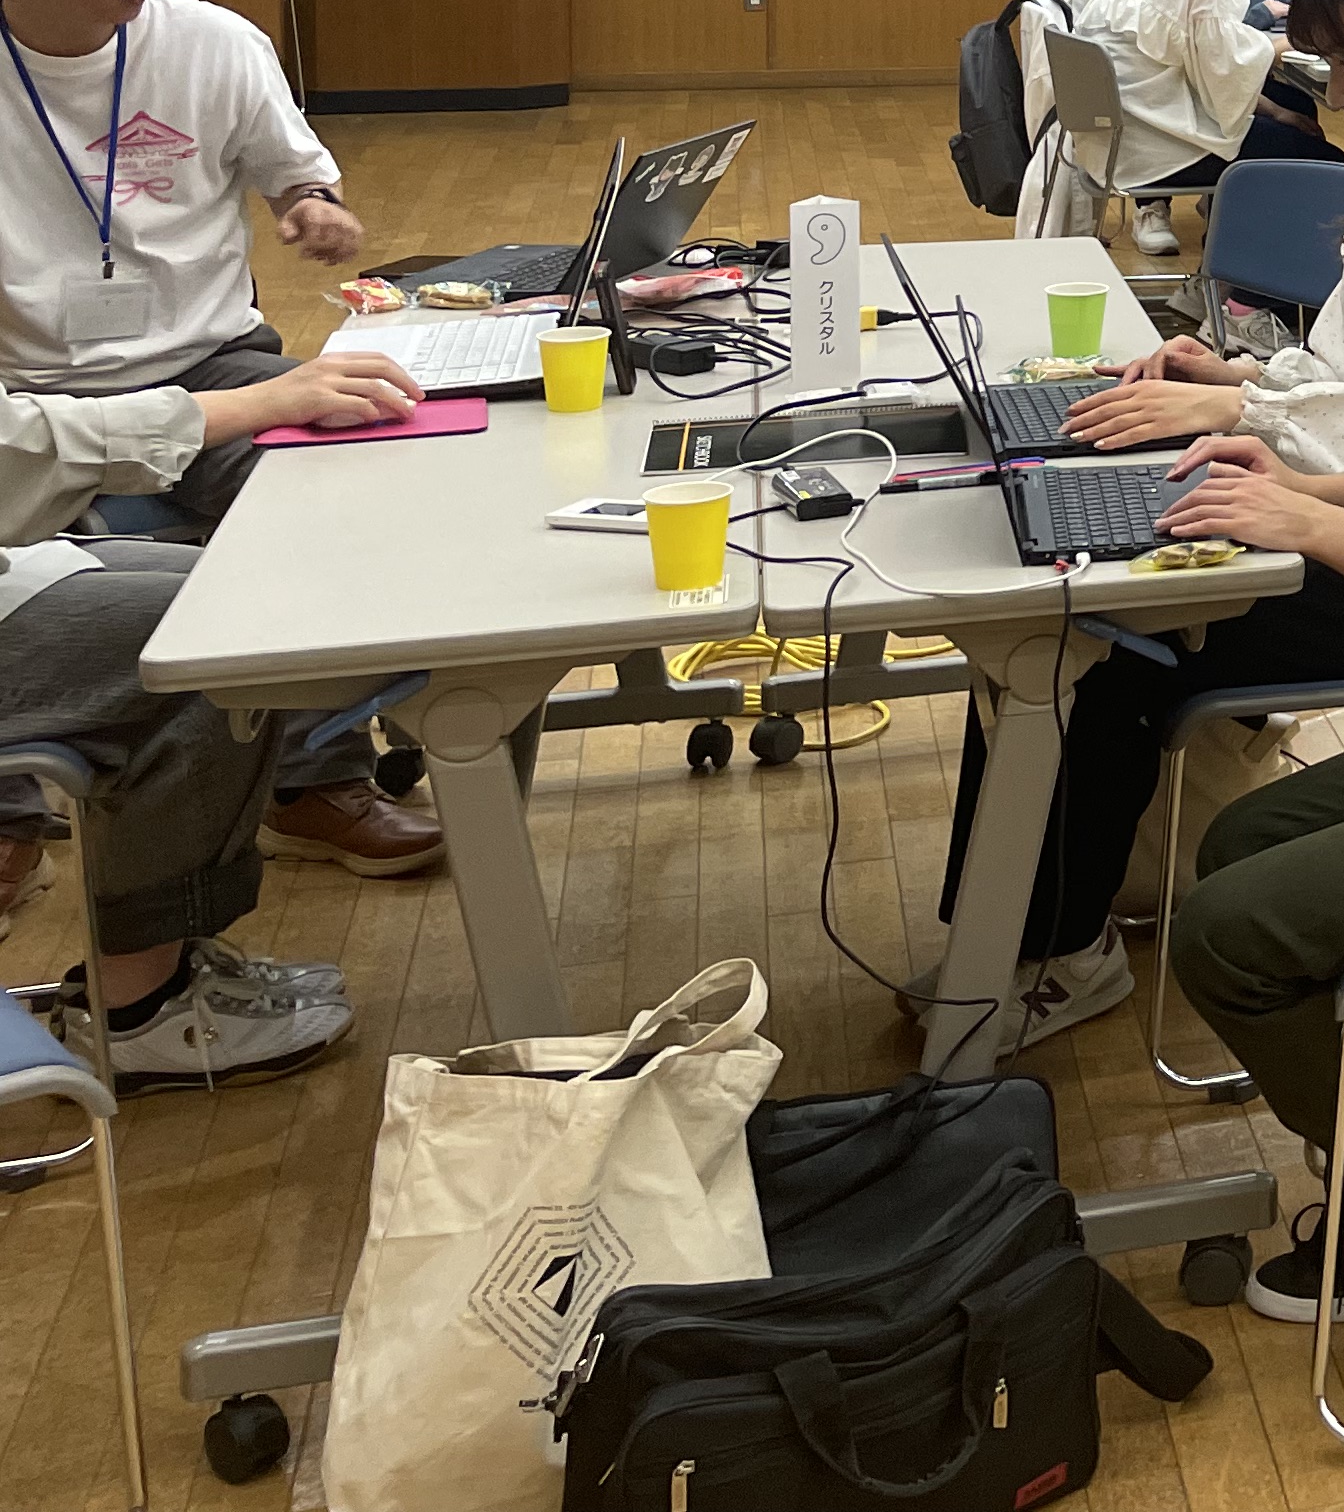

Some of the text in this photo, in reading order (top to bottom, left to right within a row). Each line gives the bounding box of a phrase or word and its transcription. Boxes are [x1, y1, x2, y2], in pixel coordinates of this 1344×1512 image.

[819, 280, 835, 355] クリスタル
